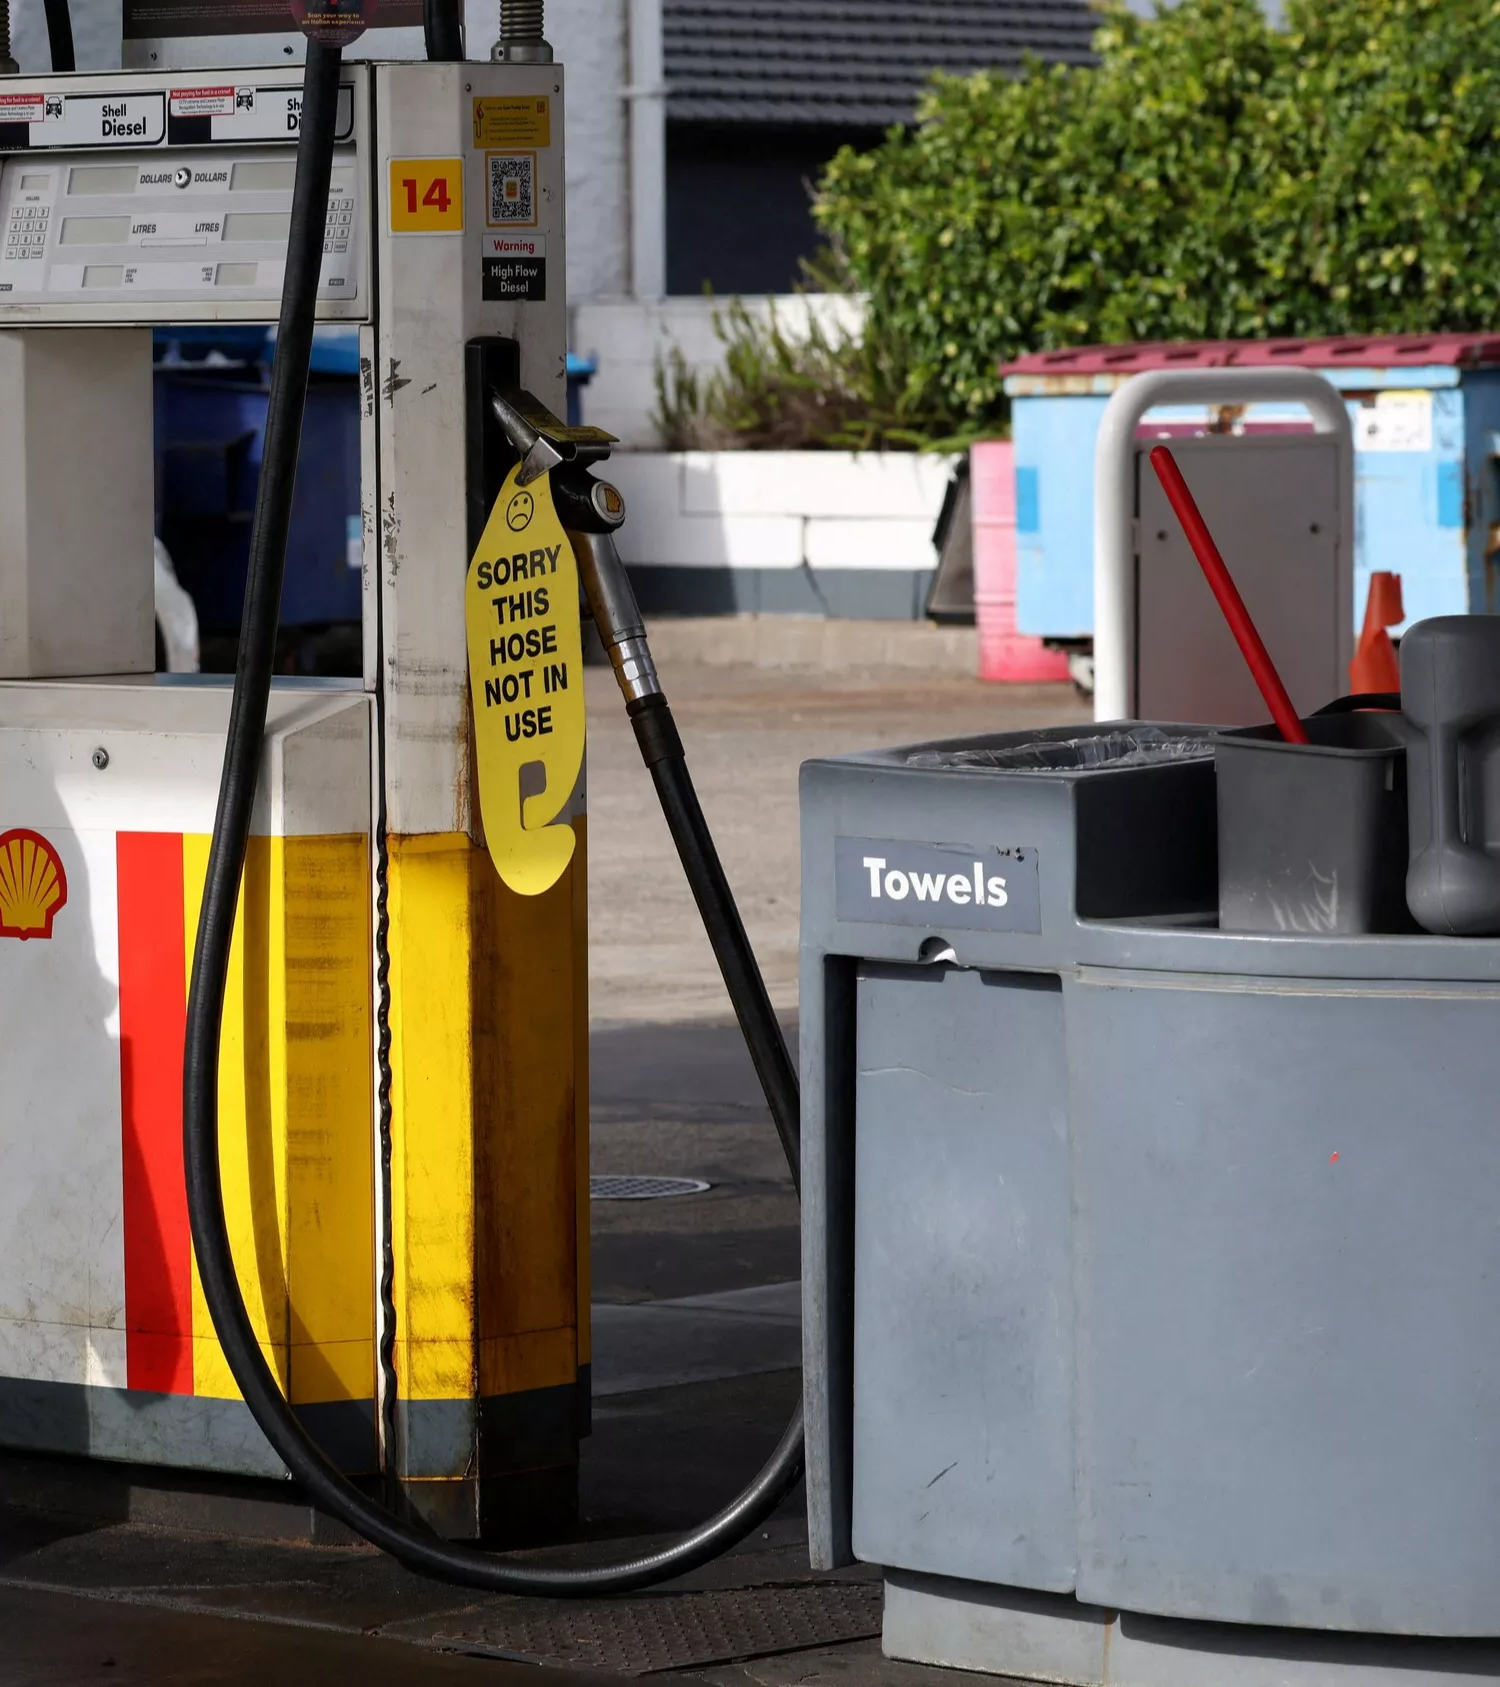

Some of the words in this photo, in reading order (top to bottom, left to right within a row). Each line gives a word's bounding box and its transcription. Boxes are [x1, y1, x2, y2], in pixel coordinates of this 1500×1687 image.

[102, 104, 126, 117] Shell
[102, 117, 146, 136] Diesel
[140, 174, 172, 184] DOLLARS
[194, 172, 228, 182] DOLLARS
[402, 178, 451, 213] 14
[132, 224, 157, 234] LITRES
[195, 223, 220, 232] LITRES
[494, 240, 535, 254] Warning
[491, 265, 513, 280] High
[515, 265, 538, 277] Flow
[500, 280, 529, 293] Diesel
[477, 544, 562, 590] SORRY
[492, 587, 550, 625] THIS
[489, 625, 558, 667] HOSE
[485, 670, 534, 707] NOT
[543, 662, 568, 694] IN
[505, 705, 553, 742] USE
[863, 856, 1008, 907] Towels
